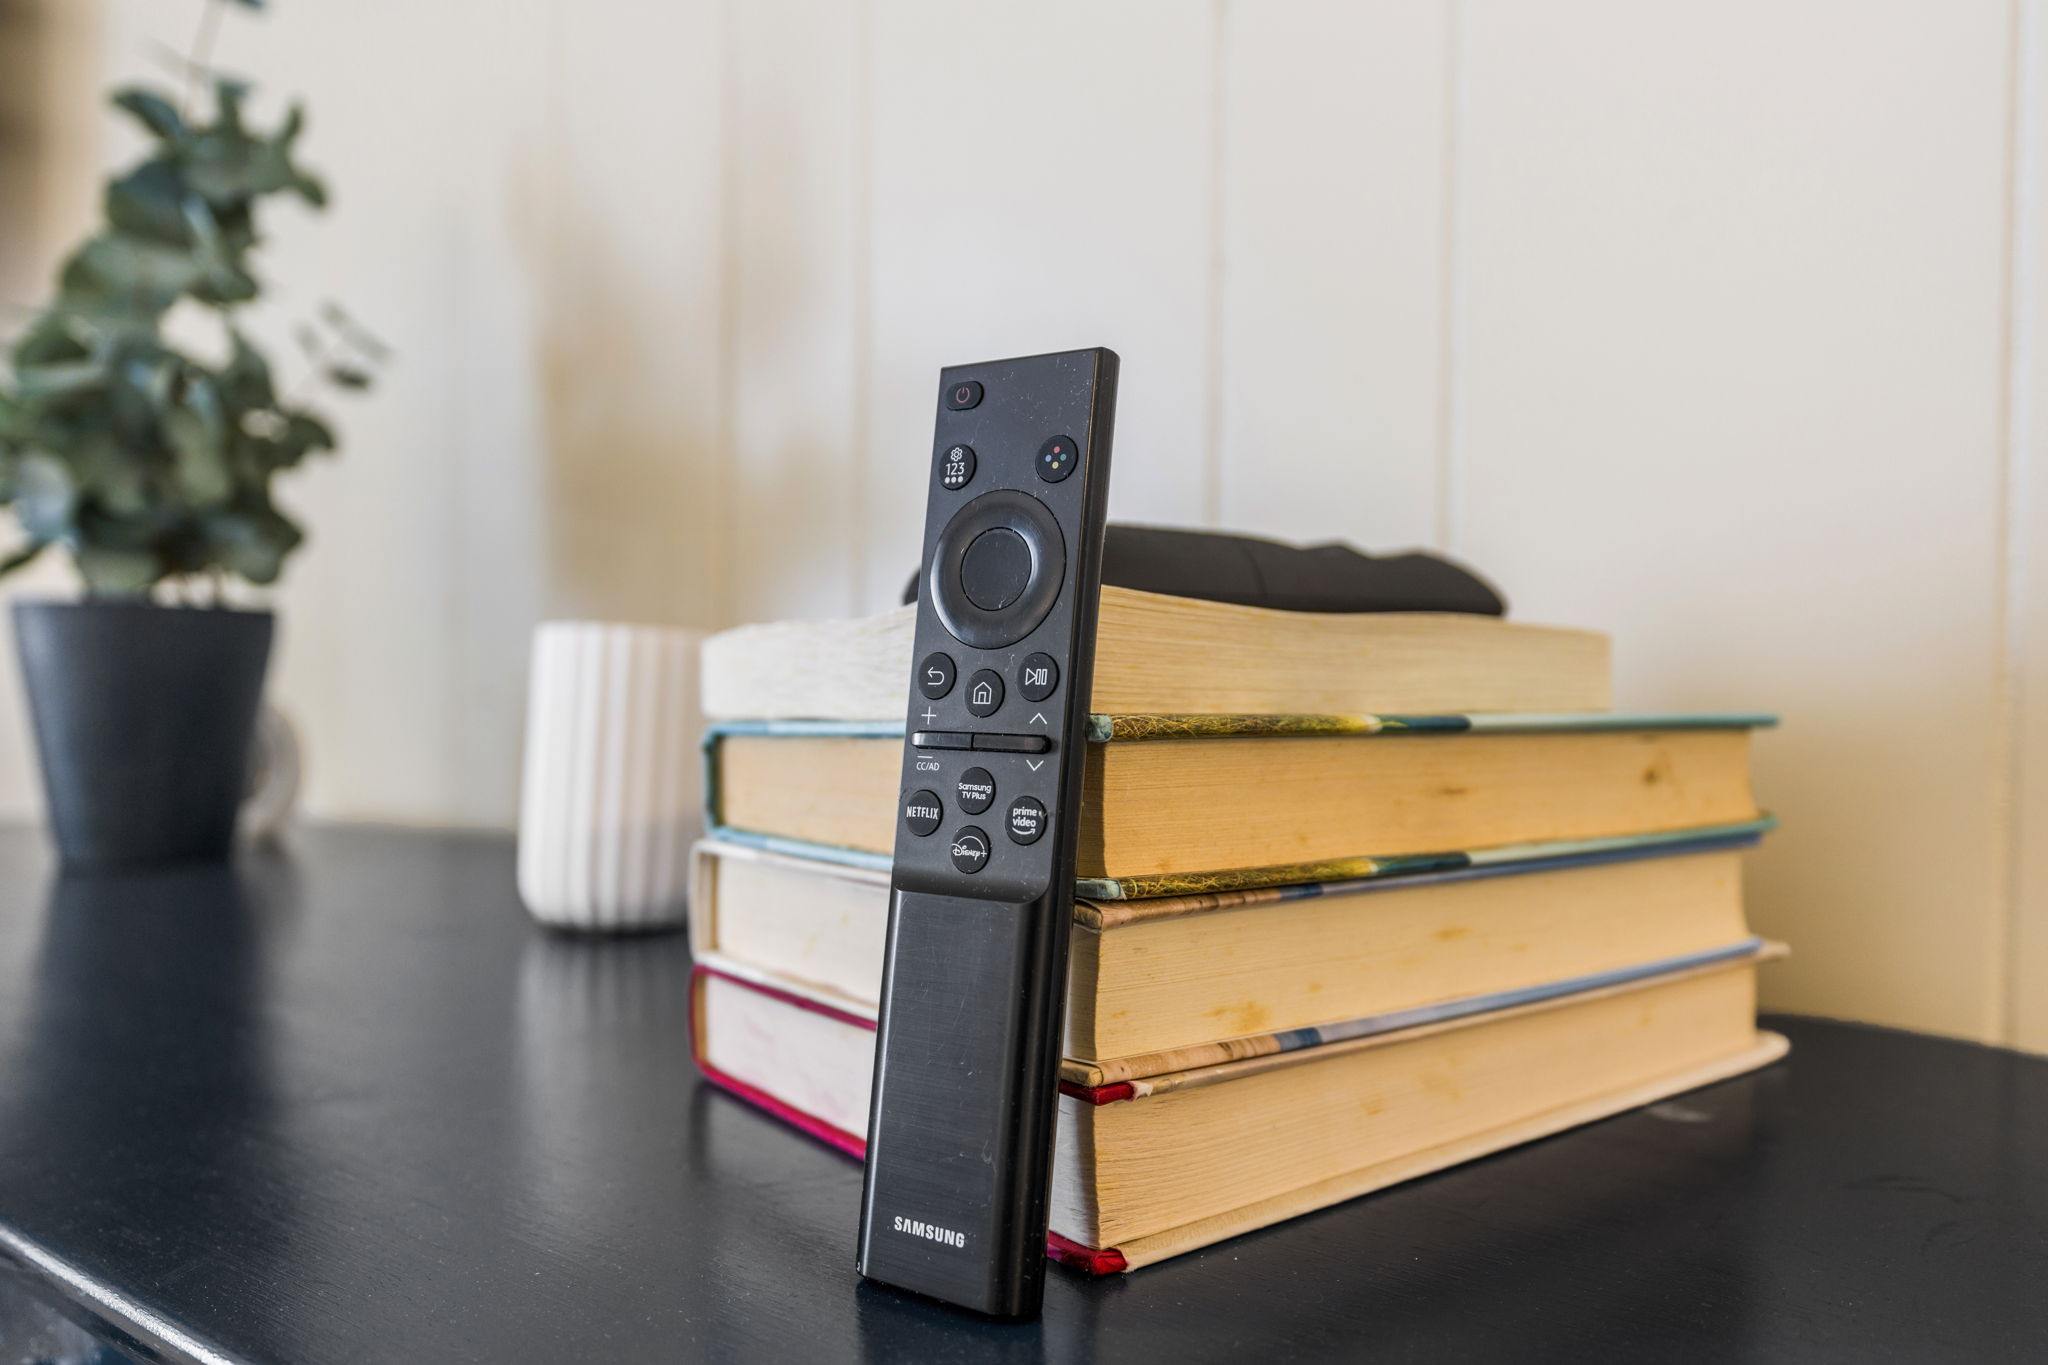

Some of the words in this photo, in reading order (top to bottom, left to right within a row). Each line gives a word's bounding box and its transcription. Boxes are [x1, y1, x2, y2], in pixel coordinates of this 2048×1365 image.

[945, 462, 965, 476] 123
[916, 762, 940, 771] CC/AD
[958, 782, 992, 794] Samsung
[962, 791, 971, 799] TV
[971, 791, 986, 800] Plus
[906, 806, 939, 820] NETFLIX
[1012, 806, 1037, 817] prime
[1012, 816, 1037, 827] video
[894, 1215, 965, 1248] SAMSUNG
